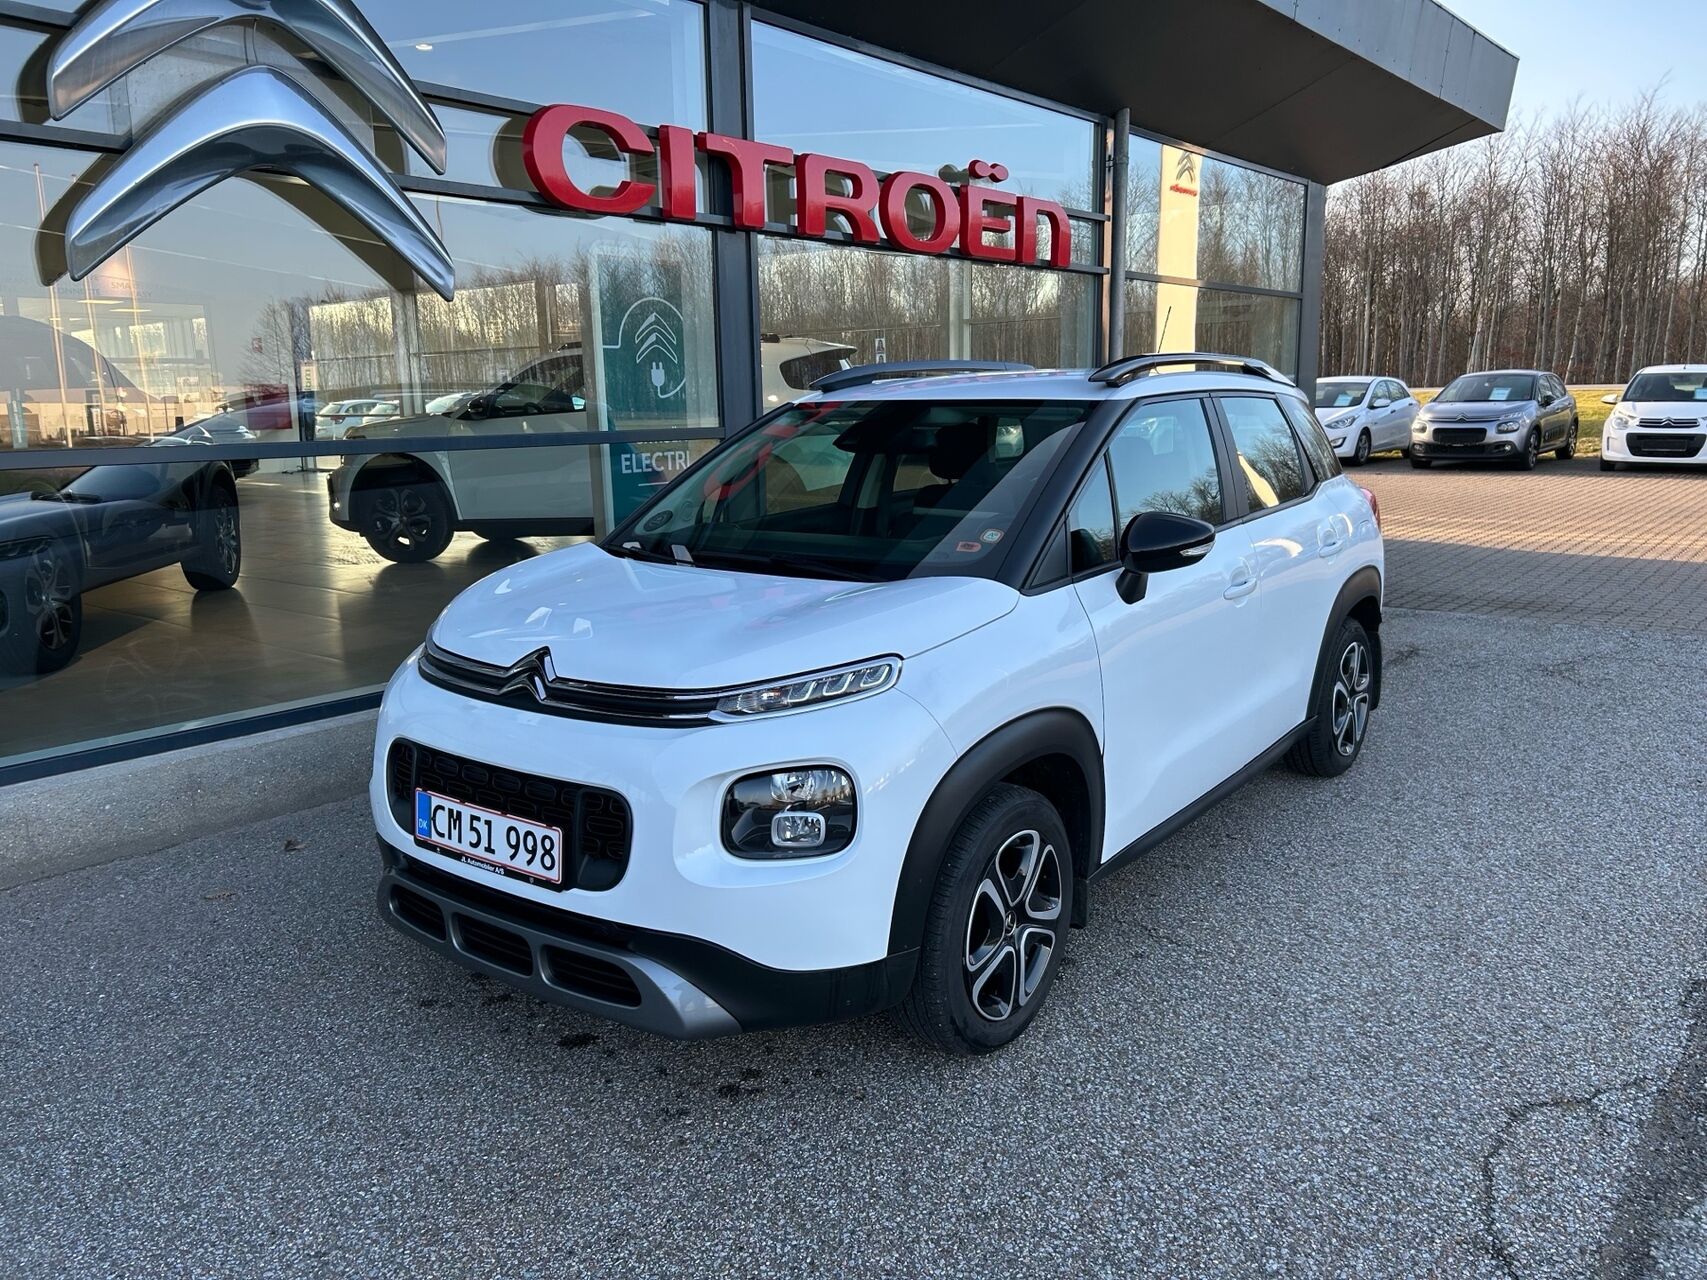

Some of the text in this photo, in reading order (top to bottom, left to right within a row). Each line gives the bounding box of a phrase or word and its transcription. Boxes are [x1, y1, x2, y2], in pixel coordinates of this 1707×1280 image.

[418, 818, 428, 830] DK
[432, 804, 556, 871] CM 51 998
